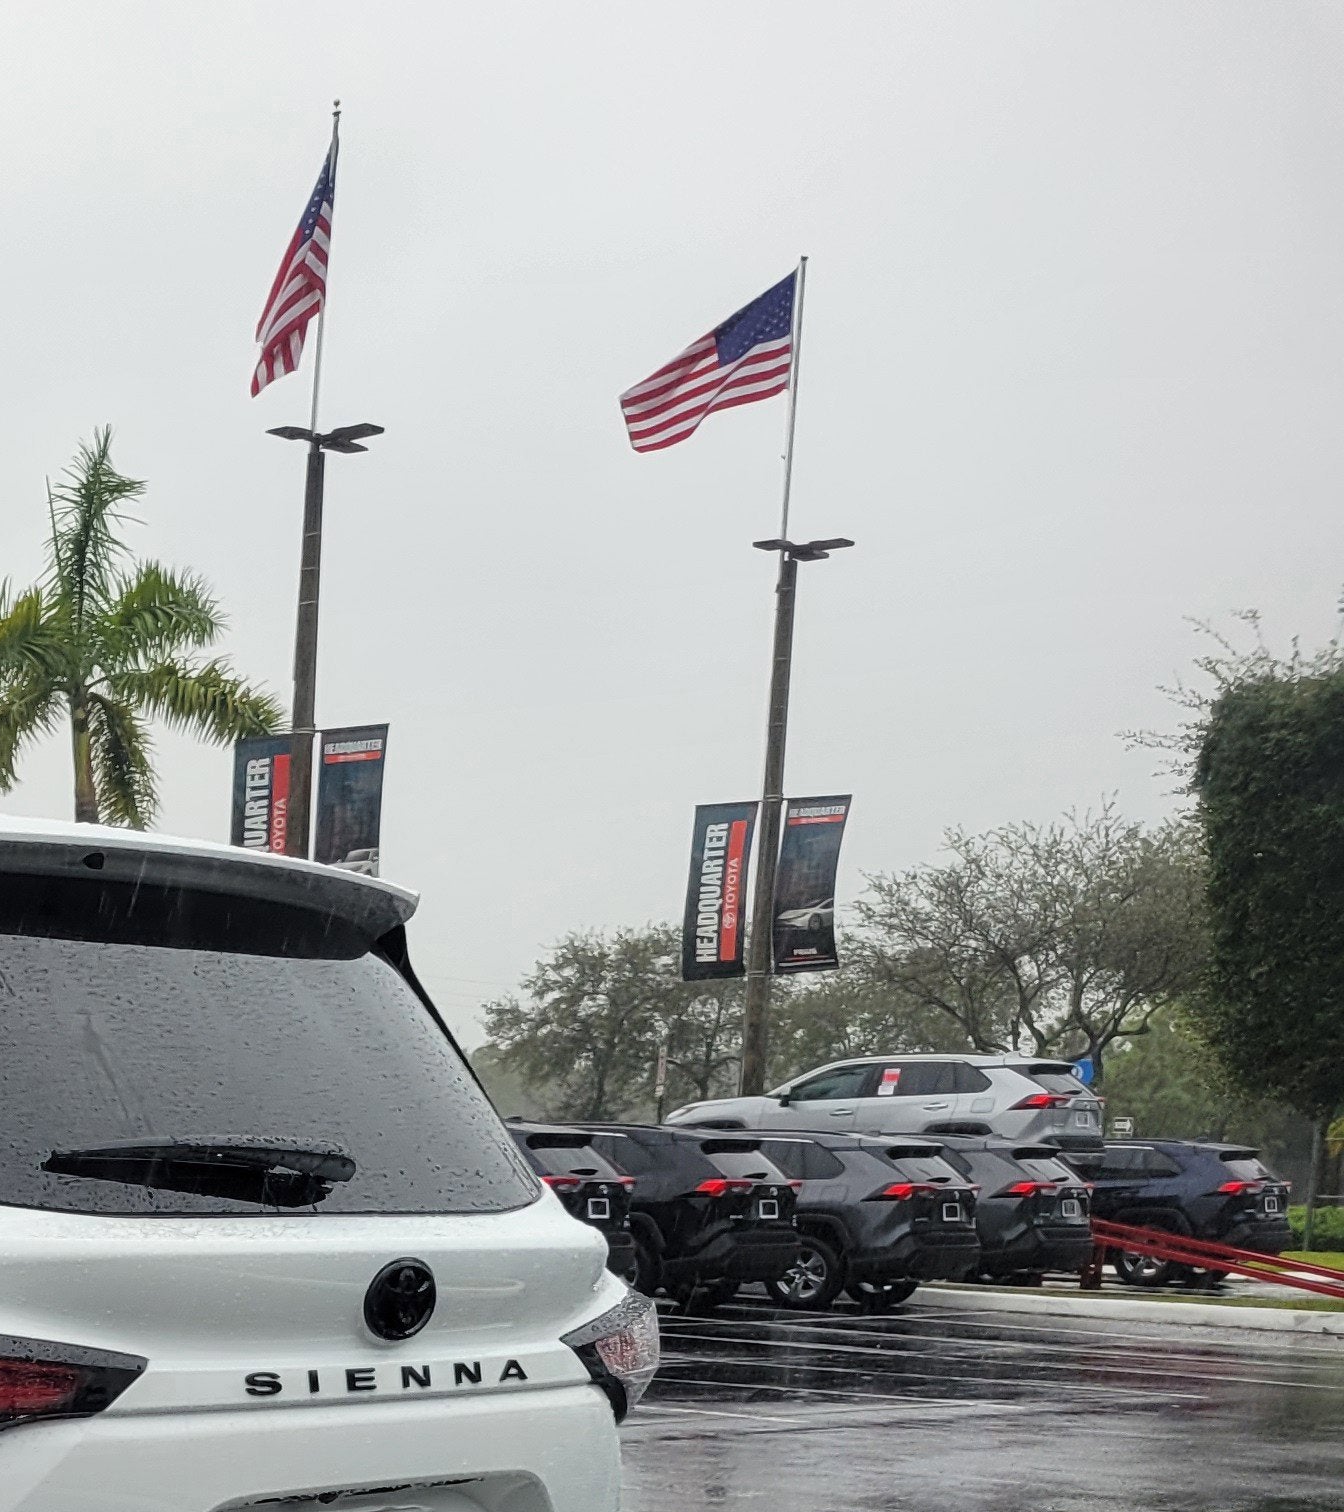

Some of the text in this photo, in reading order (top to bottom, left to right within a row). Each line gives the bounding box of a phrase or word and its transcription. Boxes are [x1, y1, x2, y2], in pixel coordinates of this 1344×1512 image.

[243, 757, 272, 852] UARTER
[271, 798, 288, 854] OYOTA
[696, 822, 729, 963] HEADQUARTER
[725, 857, 740, 911] TOYOTA
[244, 1358, 529, 1397] SIENNA
